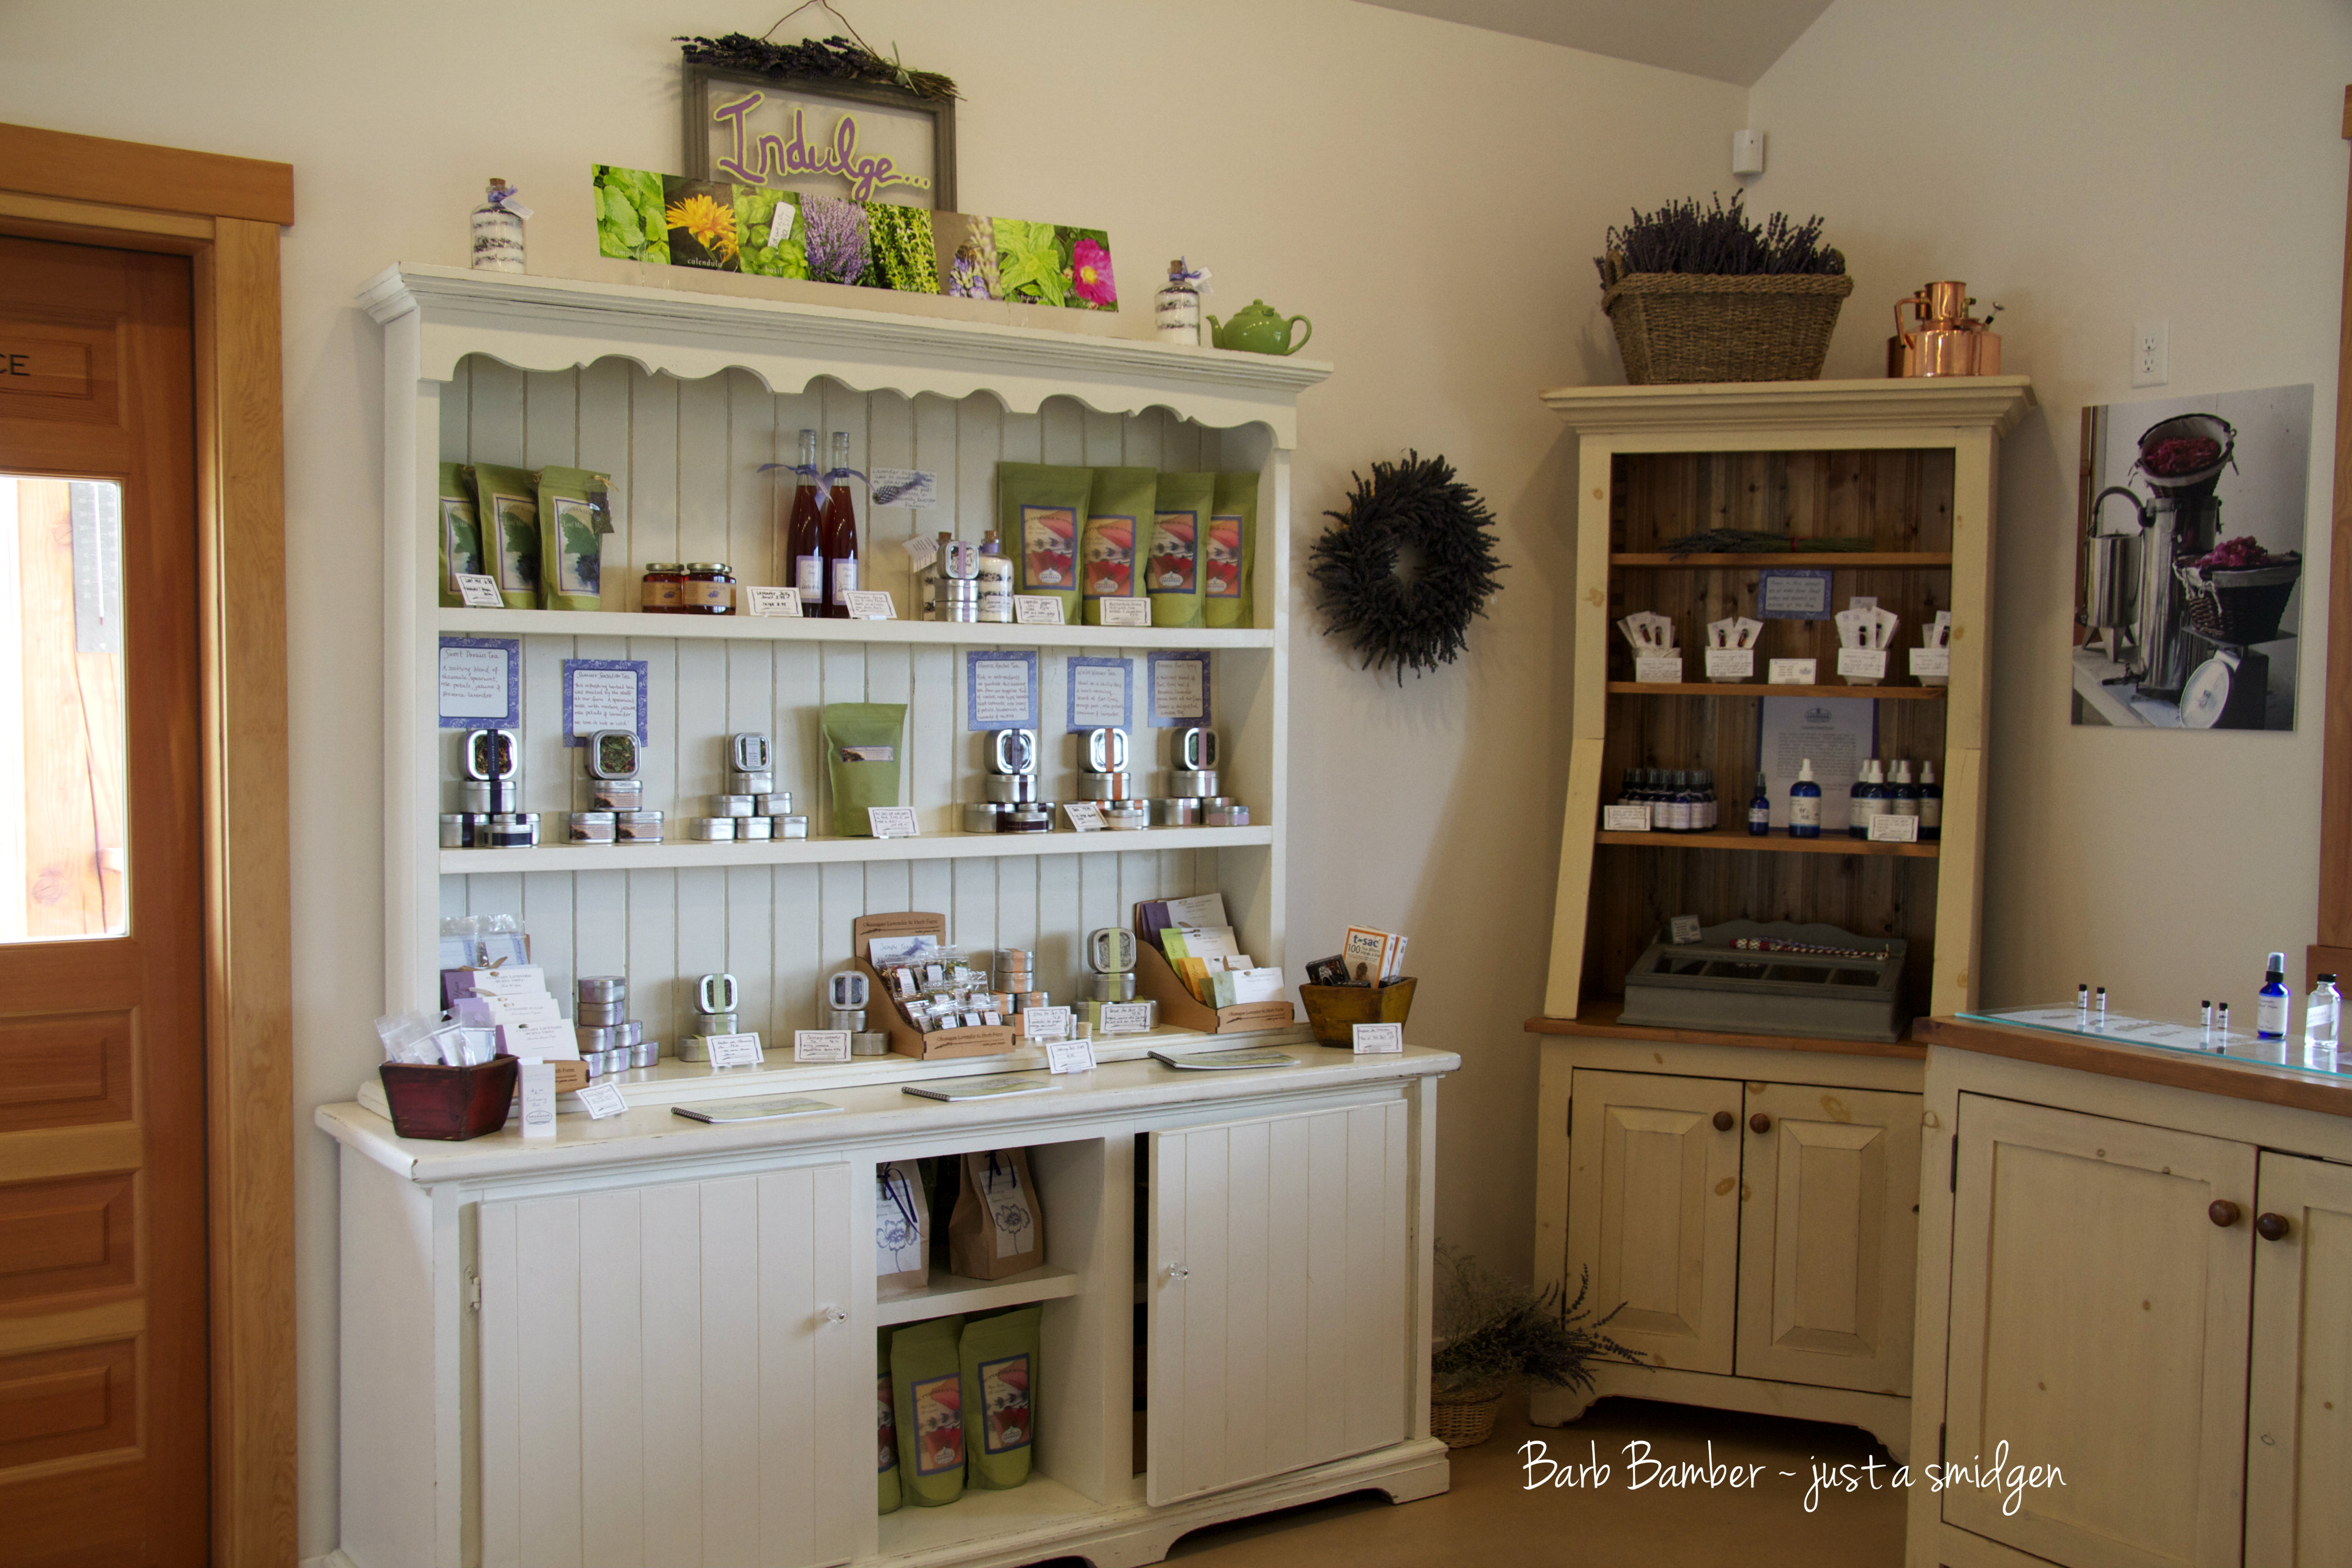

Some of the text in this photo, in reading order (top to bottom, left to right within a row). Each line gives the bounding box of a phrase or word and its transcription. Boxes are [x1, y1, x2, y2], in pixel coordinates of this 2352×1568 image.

[714, 91, 931, 201] Indulge...
[613, 247, 634, 257] lemon
[687, 257, 723, 268] calendula
[765, 265, 783, 275] basil
[444, 649, 463, 659] Sweet
[466, 650, 487, 658] Dreams
[449, 666, 472, 676] soothing
[492, 666, 499, 676] of
[1353, 934, 1379, 948] t-sac
[1348, 943, 1361, 954] 100
